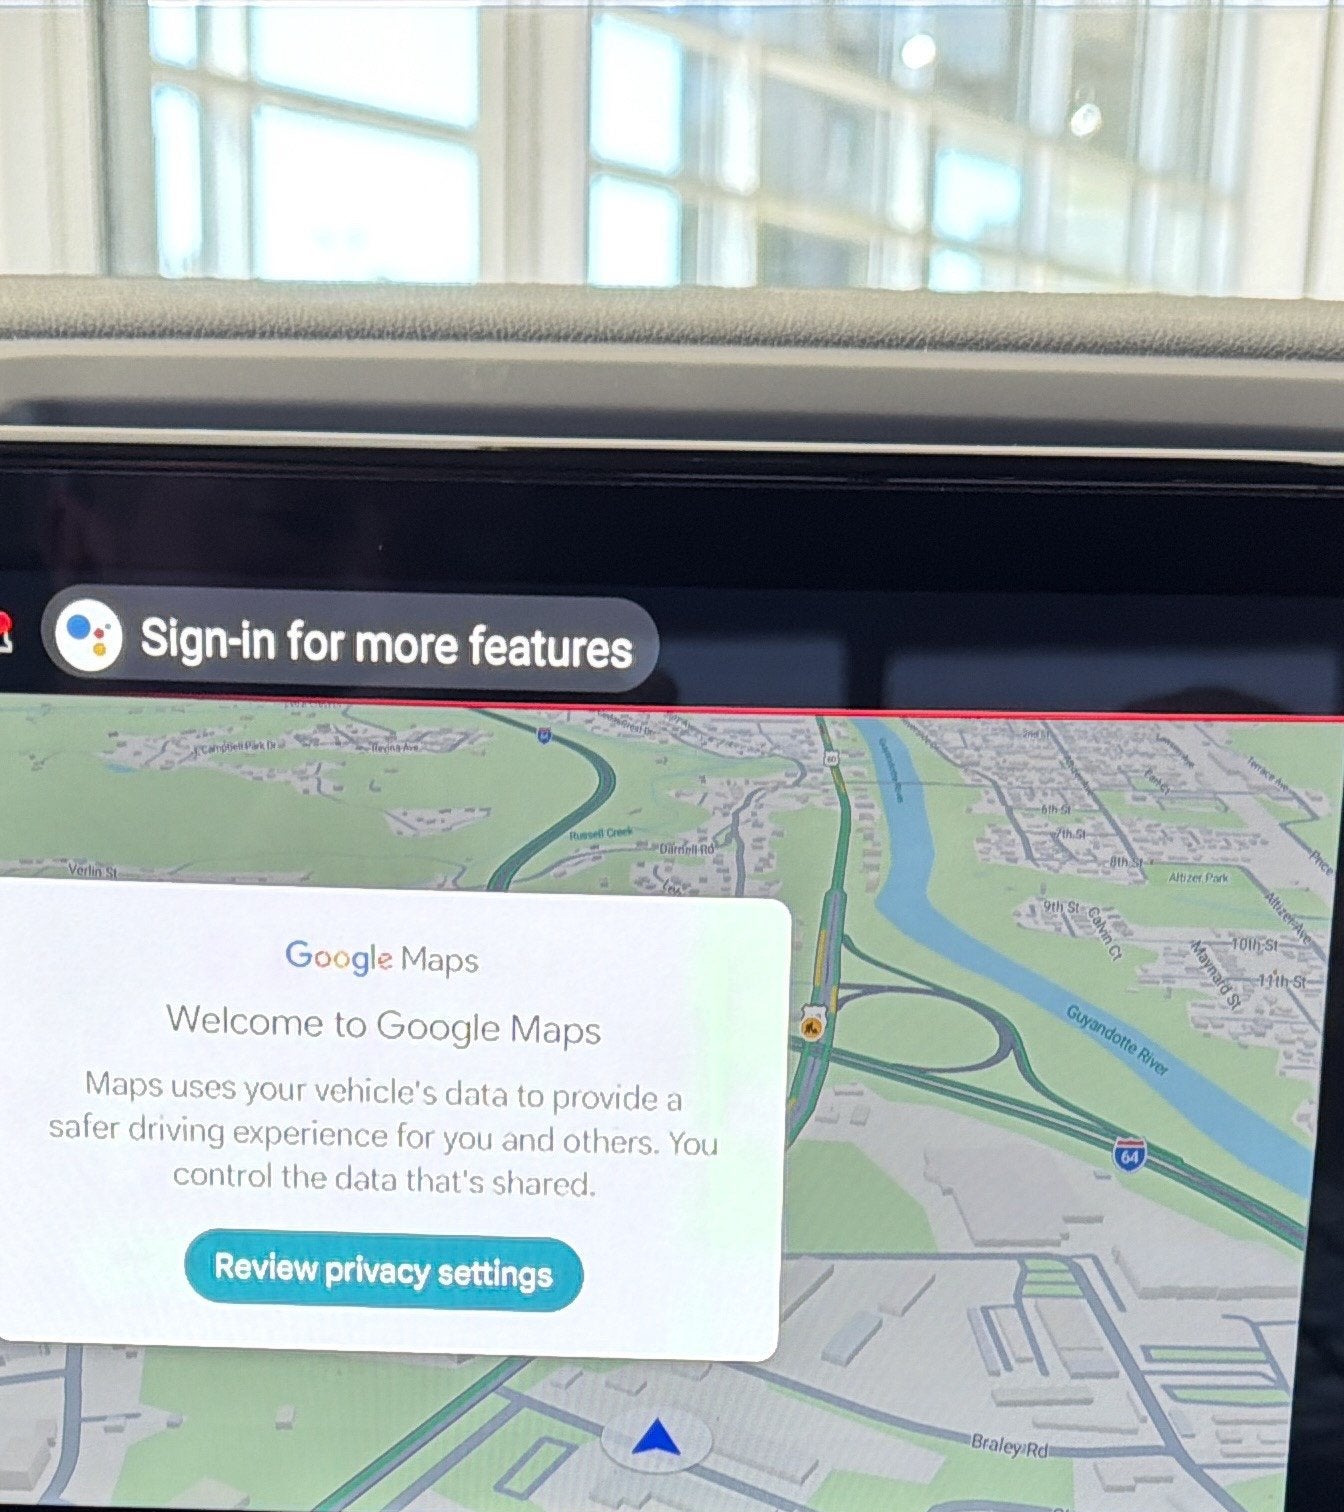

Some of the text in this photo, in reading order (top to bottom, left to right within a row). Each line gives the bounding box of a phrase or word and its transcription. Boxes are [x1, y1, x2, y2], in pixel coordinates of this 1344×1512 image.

[141, 615, 635, 670] Sign-in for more features
[1205, 871, 1229, 884] Park
[1043, 900, 1080, 914] 9th St
[1088, 906, 1123, 962] Calvin Ct
[1232, 937, 1279, 953] 10th St
[285, 938, 480, 979] Google Maps
[1190, 939, 1242, 1012] Maynard St
[1259, 974, 1307, 989] 11th St
[167, 1004, 602, 1050] Welcome to Google Maps
[1066, 1004, 1170, 1077] Guyandotte River
[85, 1070, 683, 1118] Maps uses your vehicle's data to provide a
[49, 1115, 719, 1159] safer driving experience for you and others. You
[1121, 1149, 1139, 1165] 64
[173, 1160, 596, 1198] control the data that's shared.
[215, 1251, 554, 1294] Review privacy settings
[971, 1433, 1049, 1459] Braley Rd
